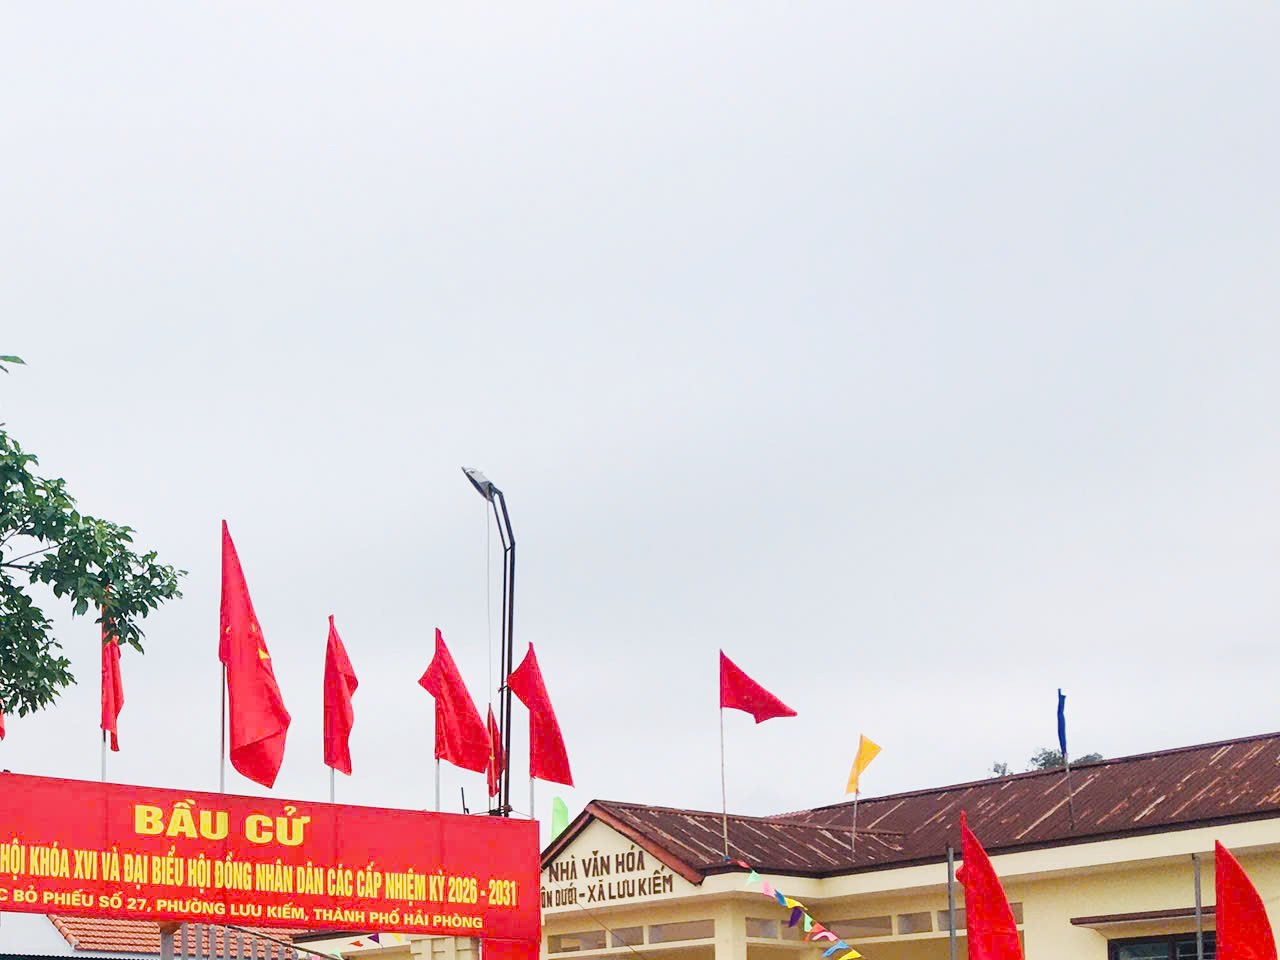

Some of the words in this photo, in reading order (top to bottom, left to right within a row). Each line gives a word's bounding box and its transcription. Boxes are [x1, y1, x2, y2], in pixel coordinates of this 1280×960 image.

[135, 799, 228, 840] BẦU
[245, 805, 311, 846] CỬ
[0, 838, 25, 880] HỘI
[29, 841, 69, 878] KHÓA
[74, 850, 97, 880] XVI
[102, 846, 120, 882] VÀ
[124, 854, 147, 890] ĐẠI
[152, 845, 184, 886] BIỂU
[188, 854, 211, 893] HỘI
[214, 852, 252, 891] ĐỒNG
[256, 859, 293, 893] NHÂN
[297, 861, 324, 895] DÂN
[327, 863, 352, 896] CÁC
[356, 862, 381, 898] CẤP
[385, 868, 426, 906] NHIỆM
[429, 869, 444, 902] KỲ
[448, 876, 477, 904] 2026
[489, 879, 516, 906] 2031
[549, 854, 577, 883] NHÀ
[615, 845, 645, 873] HÓA
[13, 885, 38, 903] BỎ
[43, 889, 94, 907] PHIẾU
[99, 891, 122, 909] SỐ
[127, 898, 151, 912] 27,
[157, 898, 225, 915] PHƯỜNG
[231, 904, 262, 917] LƯU
[267, 902, 309, 921] KIẾM,
[314, 908, 365, 922] THÀNH
[370, 908, 400, 924] PHỐ
[404, 910, 429, 926] HẢI
[433, 913, 482, 929] PHÒNG
[541, 886, 553, 908] ÔN
[608, 879, 635, 899] LƯU
[638, 865, 673, 895] KIẾM
